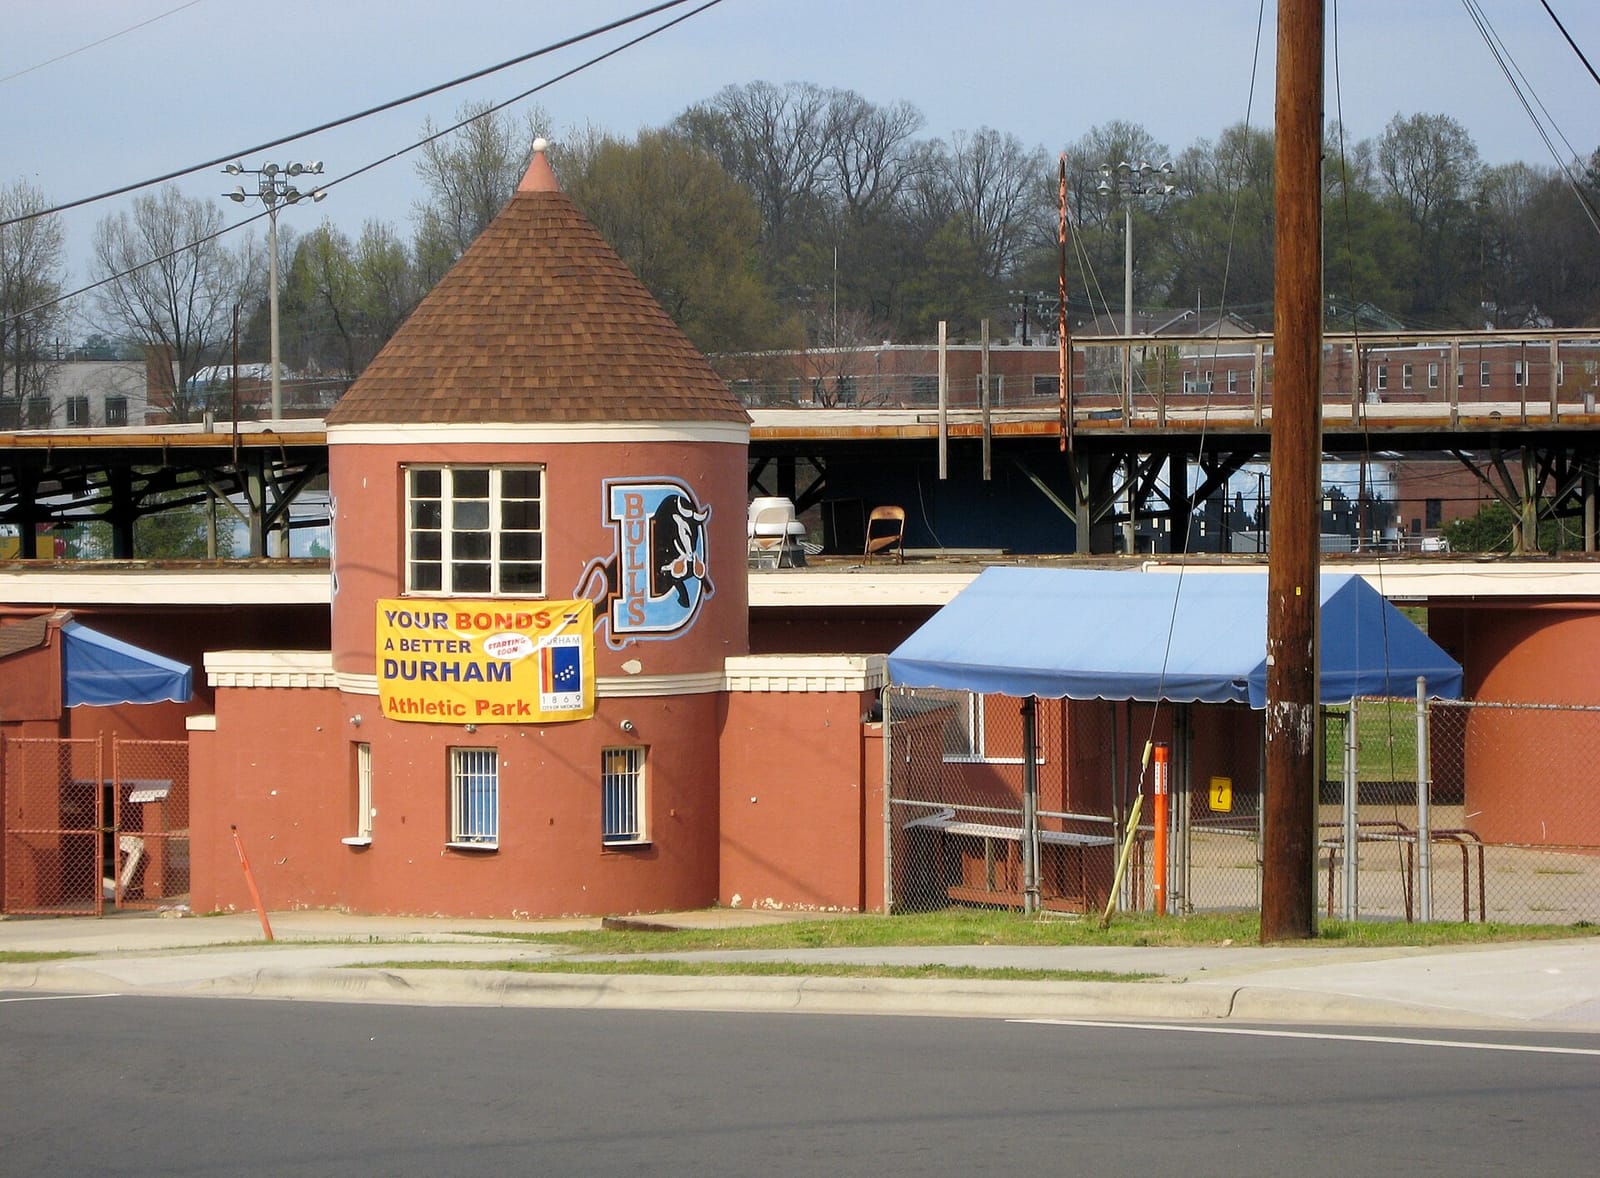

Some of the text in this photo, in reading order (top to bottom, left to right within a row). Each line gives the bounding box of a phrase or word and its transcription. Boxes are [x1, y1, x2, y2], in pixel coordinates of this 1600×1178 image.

[624, 493, 646, 626] BULLS
[384, 610, 449, 630] YOUR
[455, 611, 551, 631] BONDS
[384, 638, 472, 654] A BETTER
[488, 637, 526, 650] STARTING
[541, 636, 580, 646] URHAM
[383, 658, 512, 683] DURHAM
[388, 696, 532, 717] Athletic Park
[1217, 785, 1223, 804] 2
